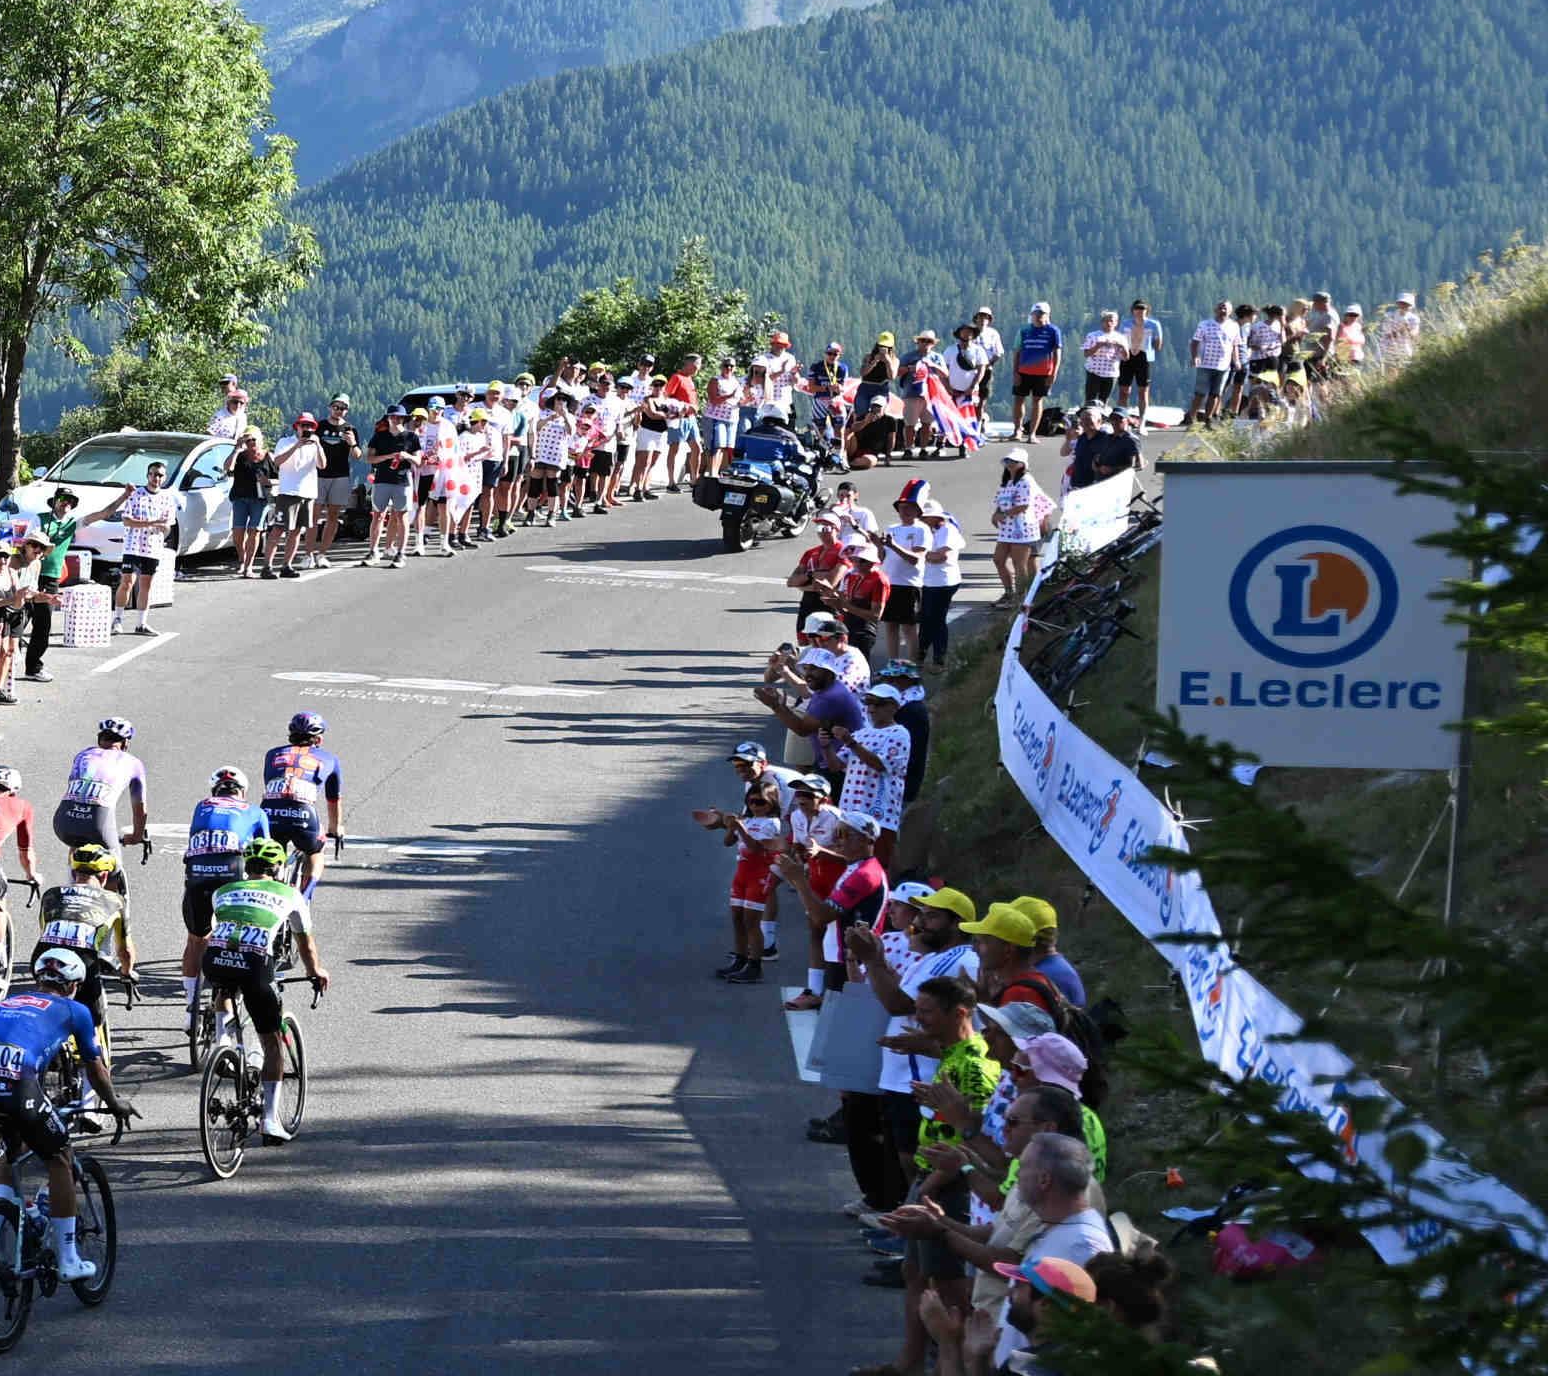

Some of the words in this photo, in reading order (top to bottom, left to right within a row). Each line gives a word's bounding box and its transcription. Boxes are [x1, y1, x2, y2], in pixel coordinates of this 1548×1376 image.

[1271, 564, 1341, 637] L
[1179, 671, 1441, 711] E.Leclerc
[273, 807, 310, 820] raisin
[241, 926, 269, 947] 225
